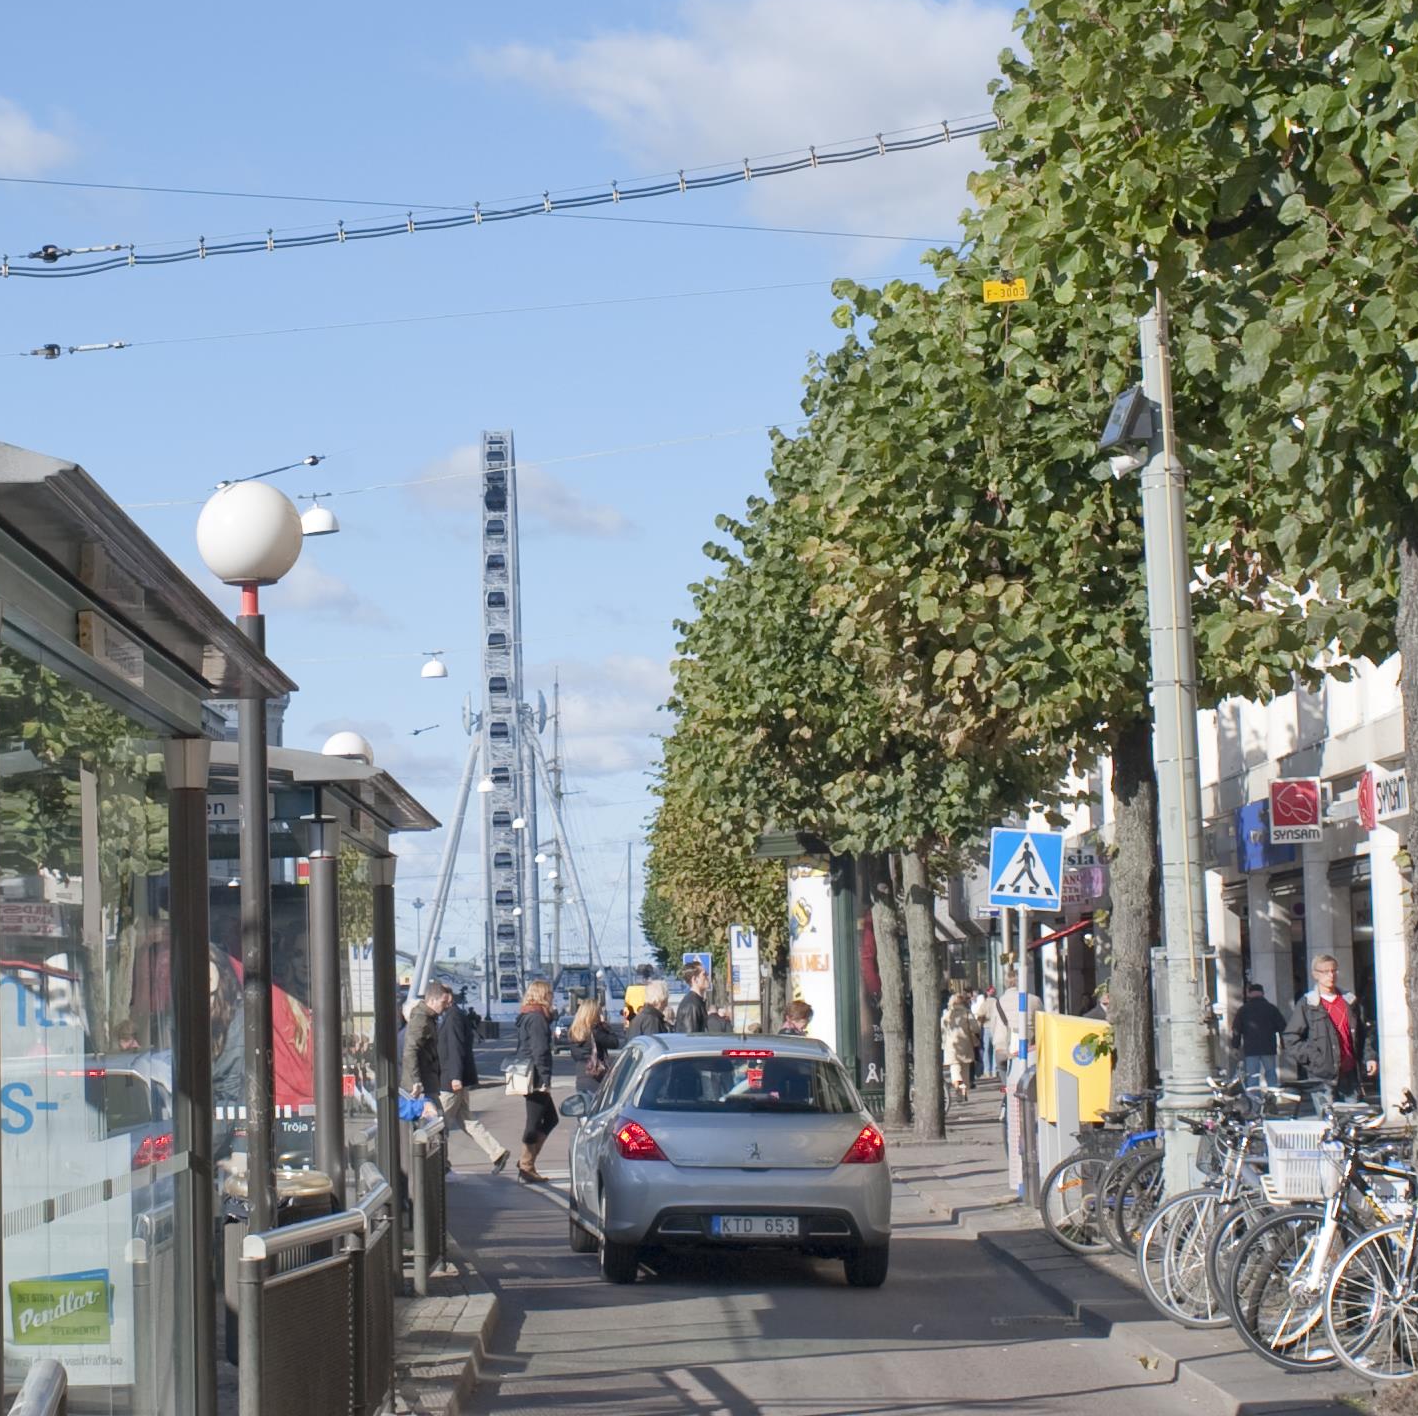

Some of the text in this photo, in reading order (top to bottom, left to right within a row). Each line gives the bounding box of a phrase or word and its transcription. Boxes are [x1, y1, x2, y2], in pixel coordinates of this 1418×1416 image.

[1273, 828, 1321, 841] SYNSAM
[282, 1121, 308, 1133] Tröja
[722, 1218, 795, 1232] KTD 653
